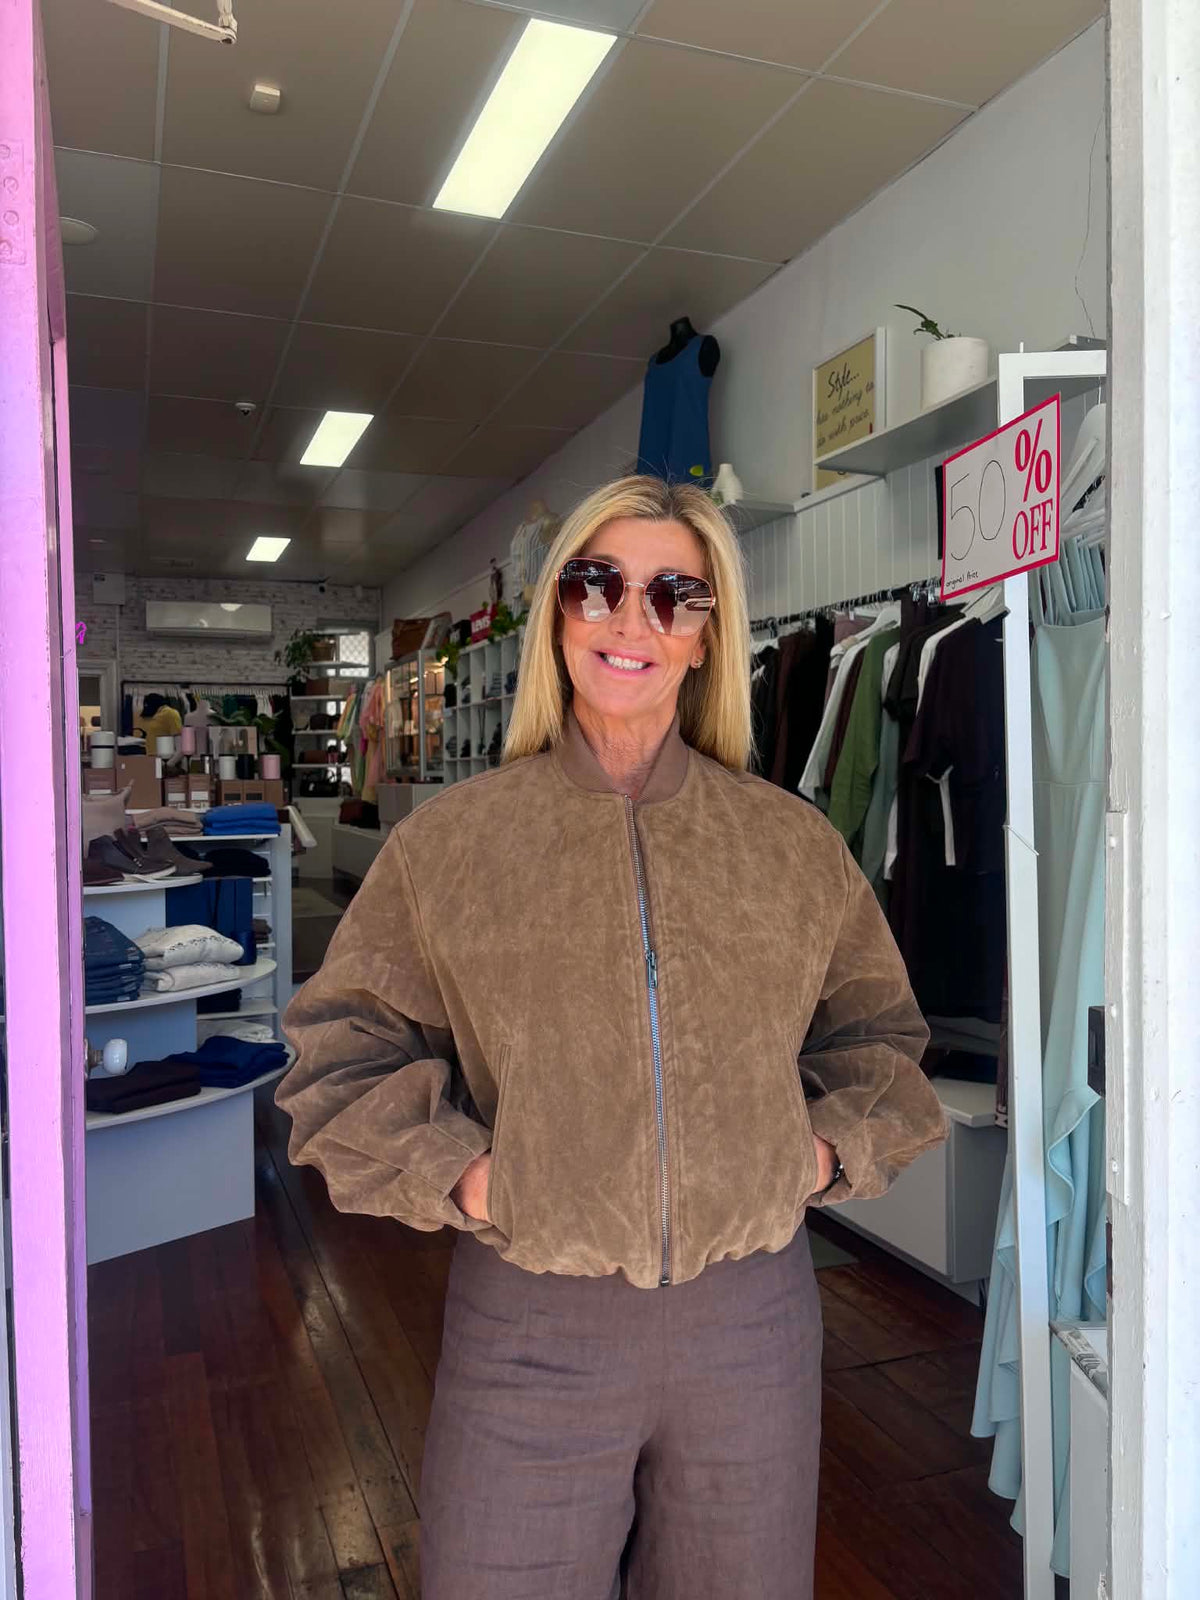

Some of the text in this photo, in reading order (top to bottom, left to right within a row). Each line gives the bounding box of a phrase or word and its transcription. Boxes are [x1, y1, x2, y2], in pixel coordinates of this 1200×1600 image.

[832, 390, 862, 414] nothing
[829, 415, 847, 440] with
[950, 459, 1006, 561] 50
[1012, 498, 1054, 560] OFF
